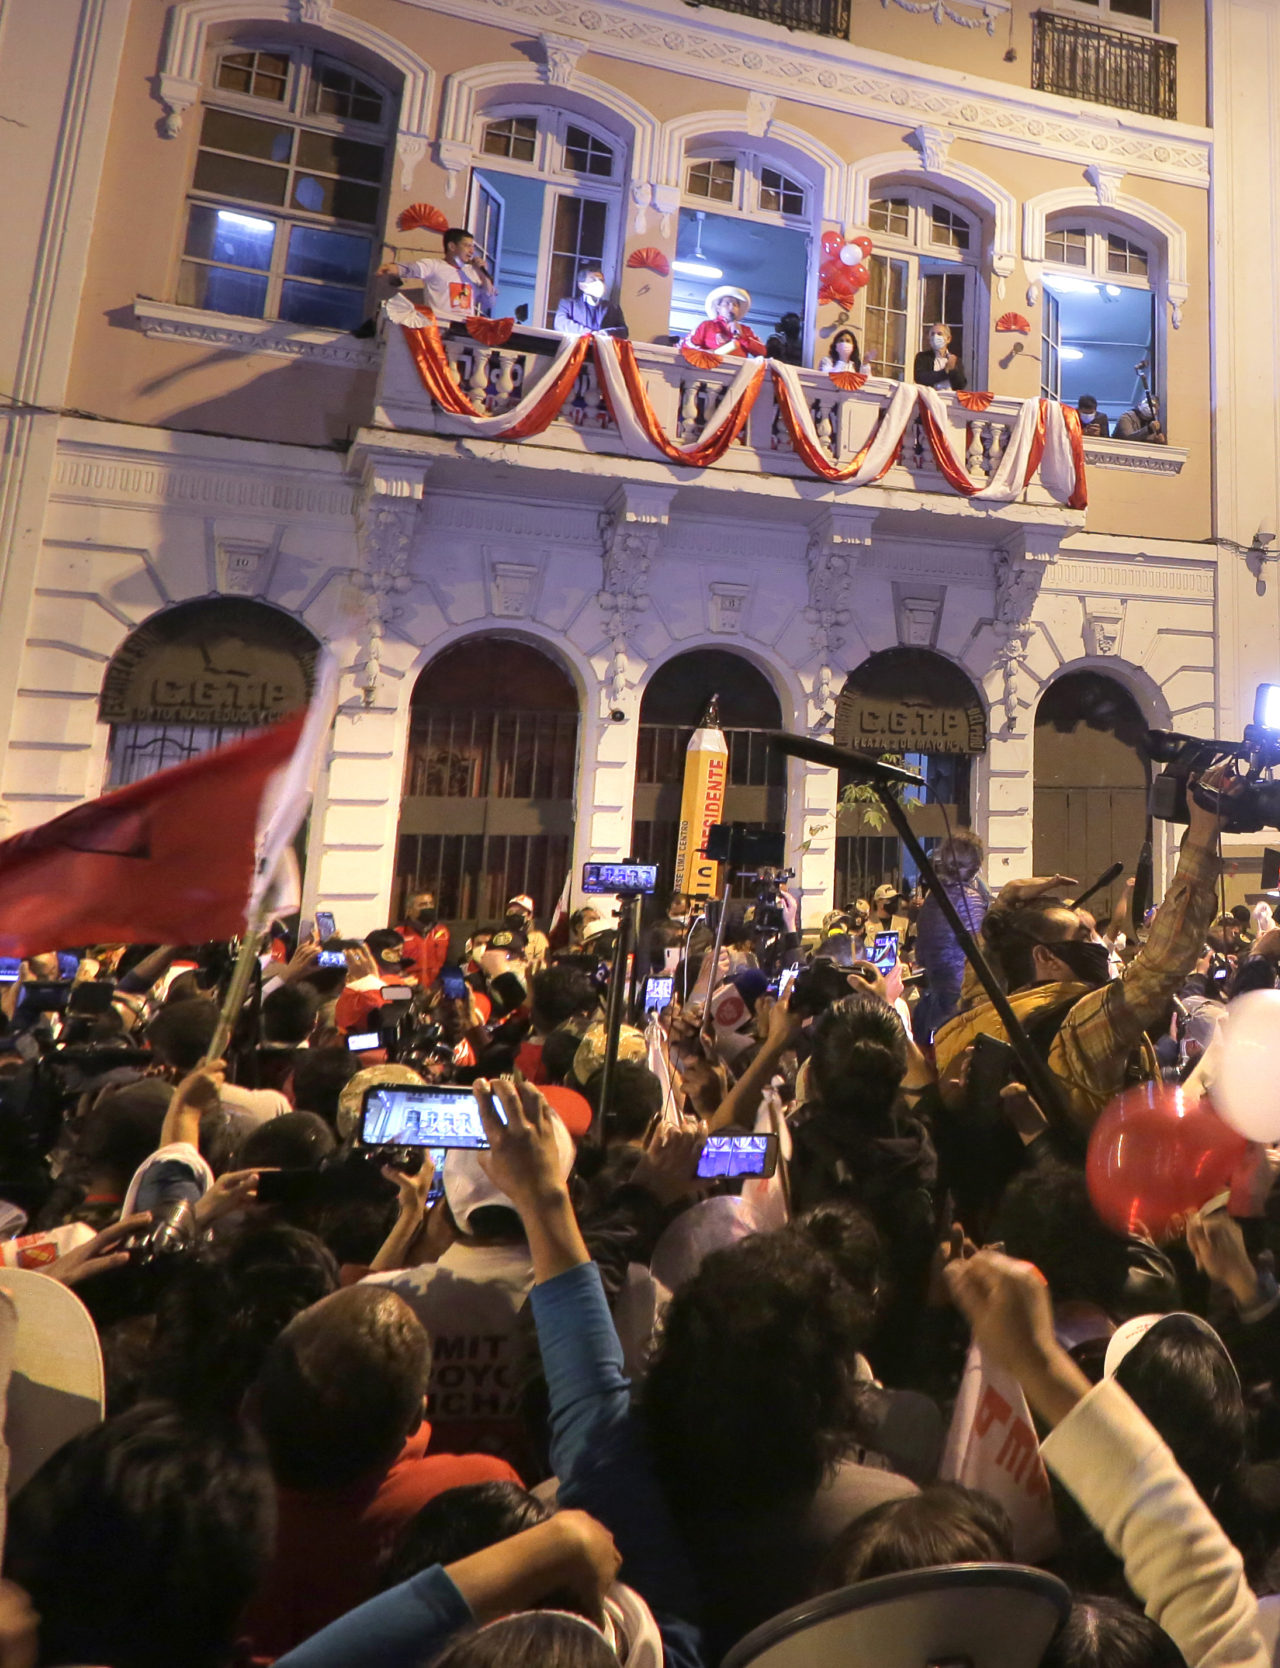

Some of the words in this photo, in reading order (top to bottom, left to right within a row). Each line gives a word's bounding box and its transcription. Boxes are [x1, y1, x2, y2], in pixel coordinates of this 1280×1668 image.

[678, 820, 689, 851] CENTRO
[677, 852, 687, 873] LIMA
[433, 1335, 510, 1360] MIT
